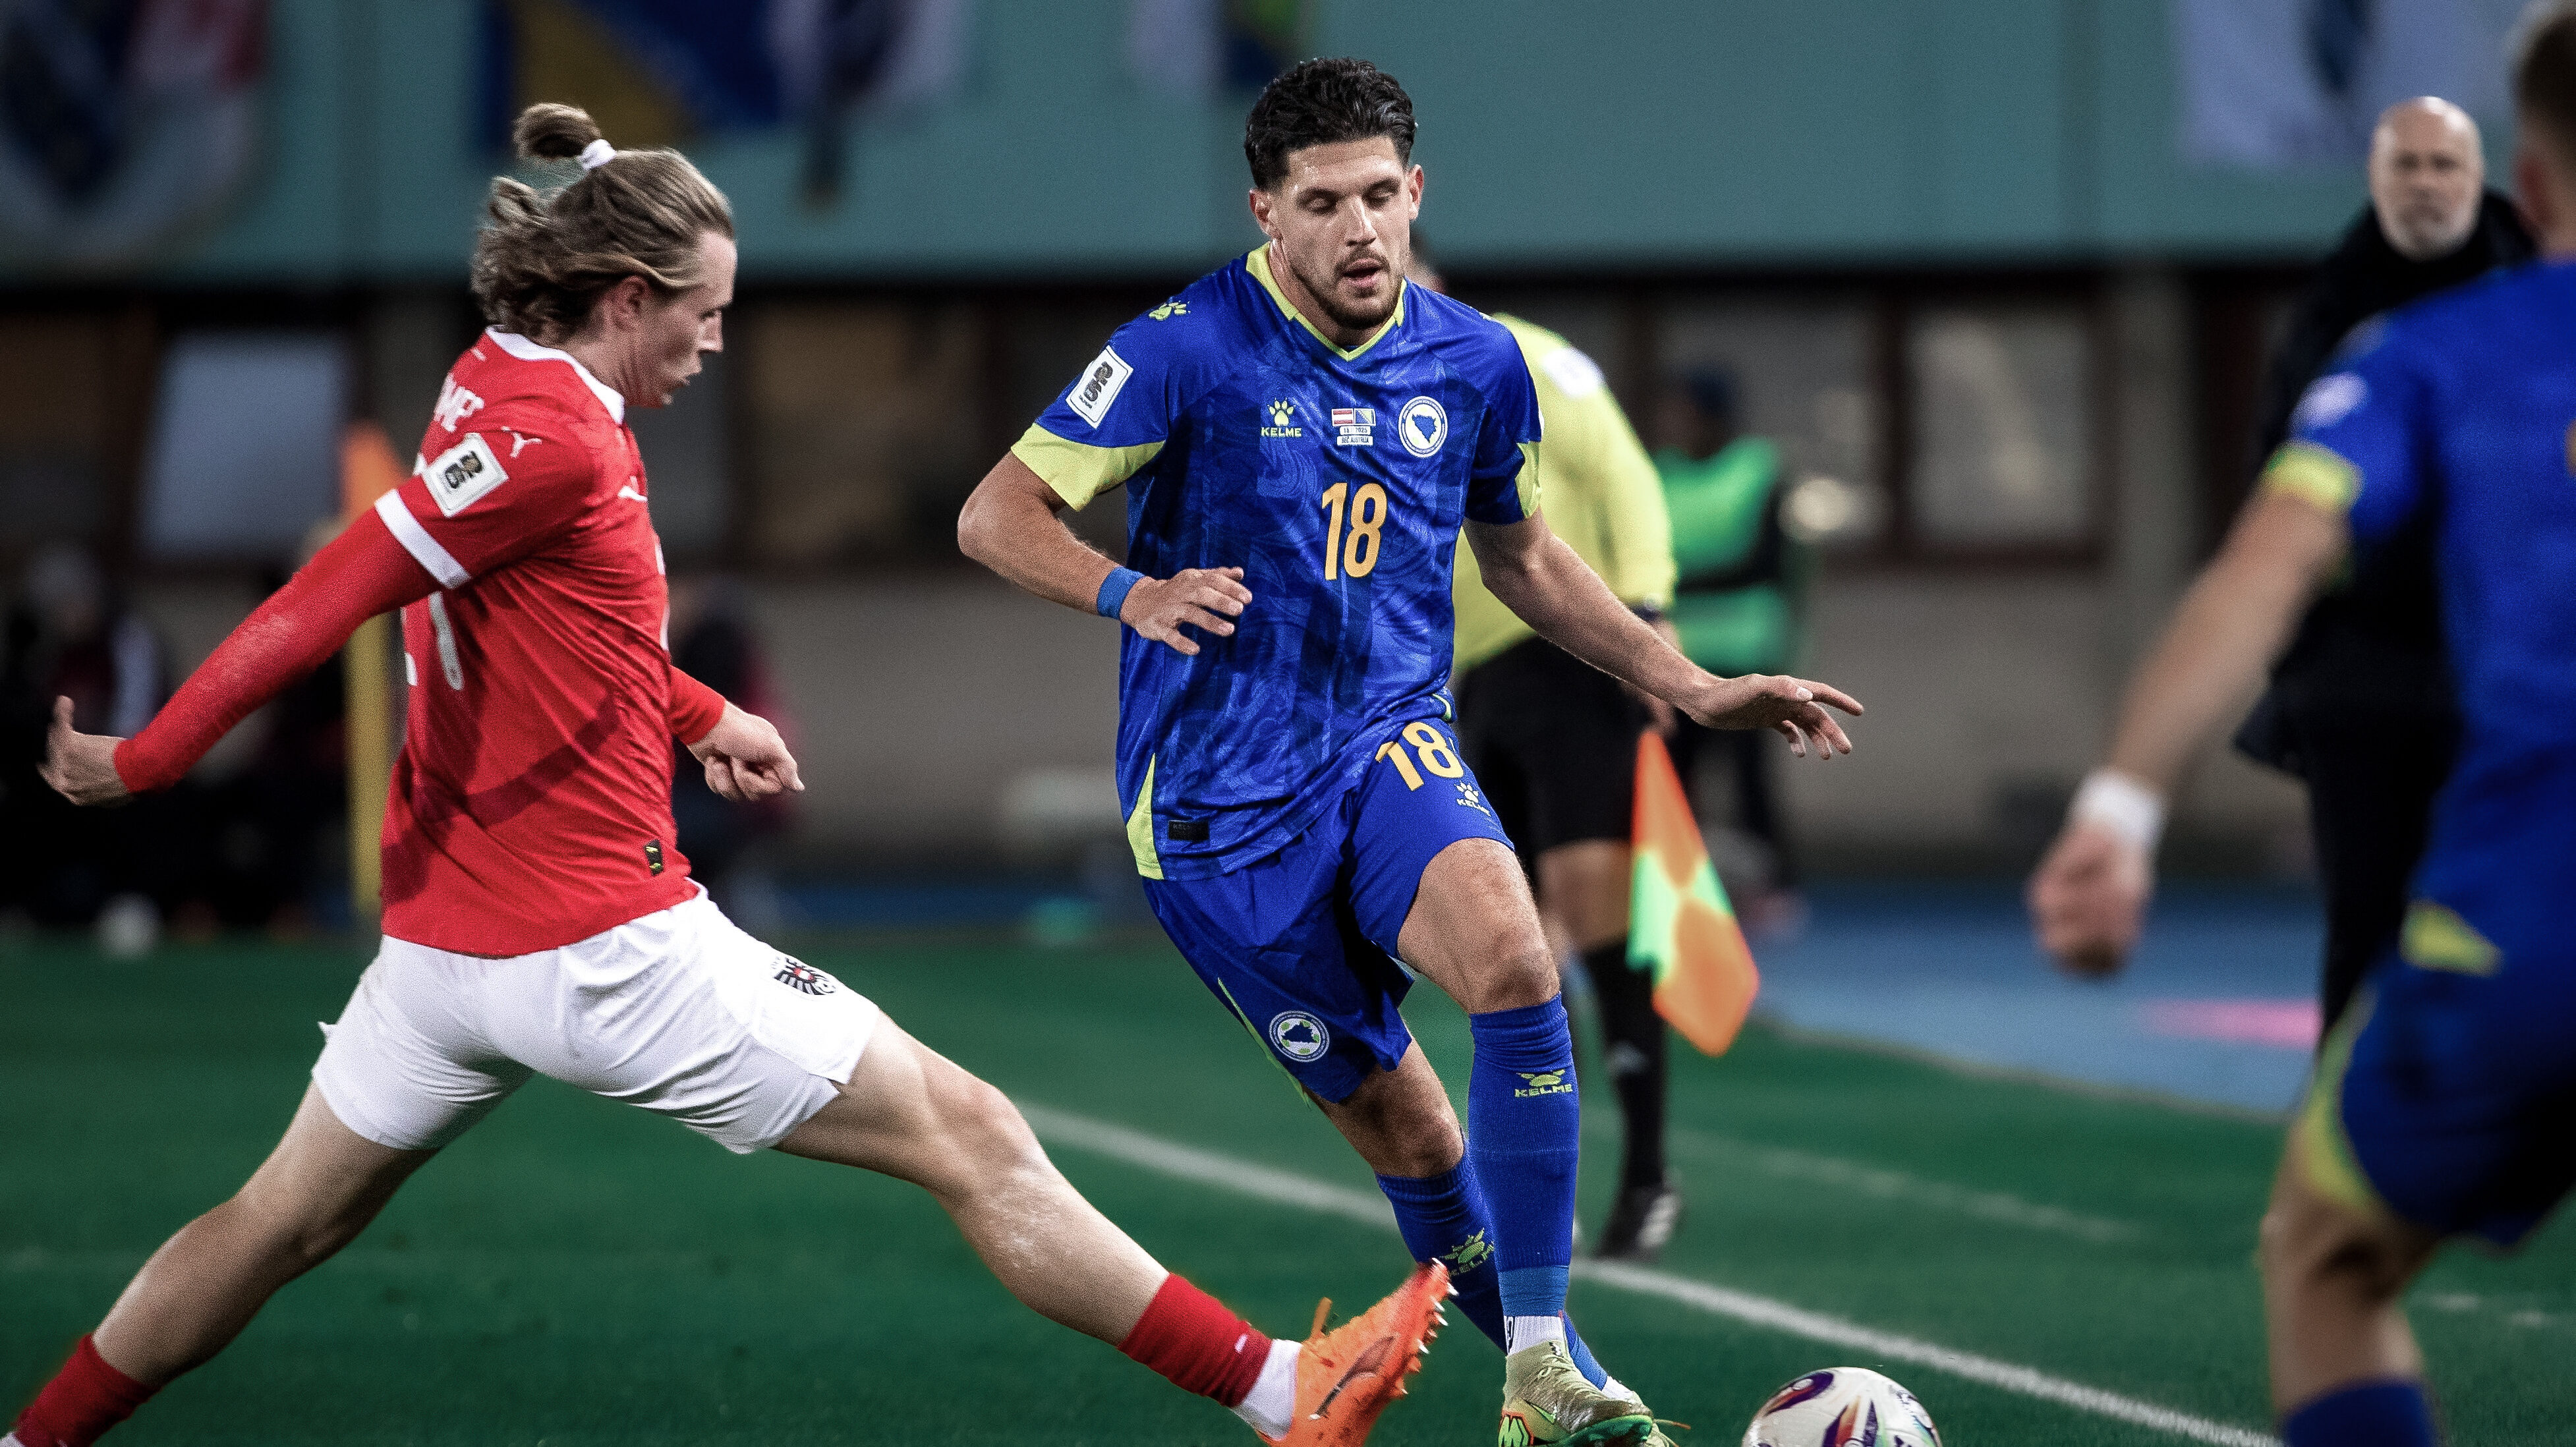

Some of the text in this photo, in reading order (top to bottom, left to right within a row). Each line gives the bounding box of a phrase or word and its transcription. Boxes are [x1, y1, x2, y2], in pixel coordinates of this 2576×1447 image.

[1261, 426, 1302, 438] KELME
[1321, 482, 1387, 581] 18
[1375, 722, 1464, 792] 18
